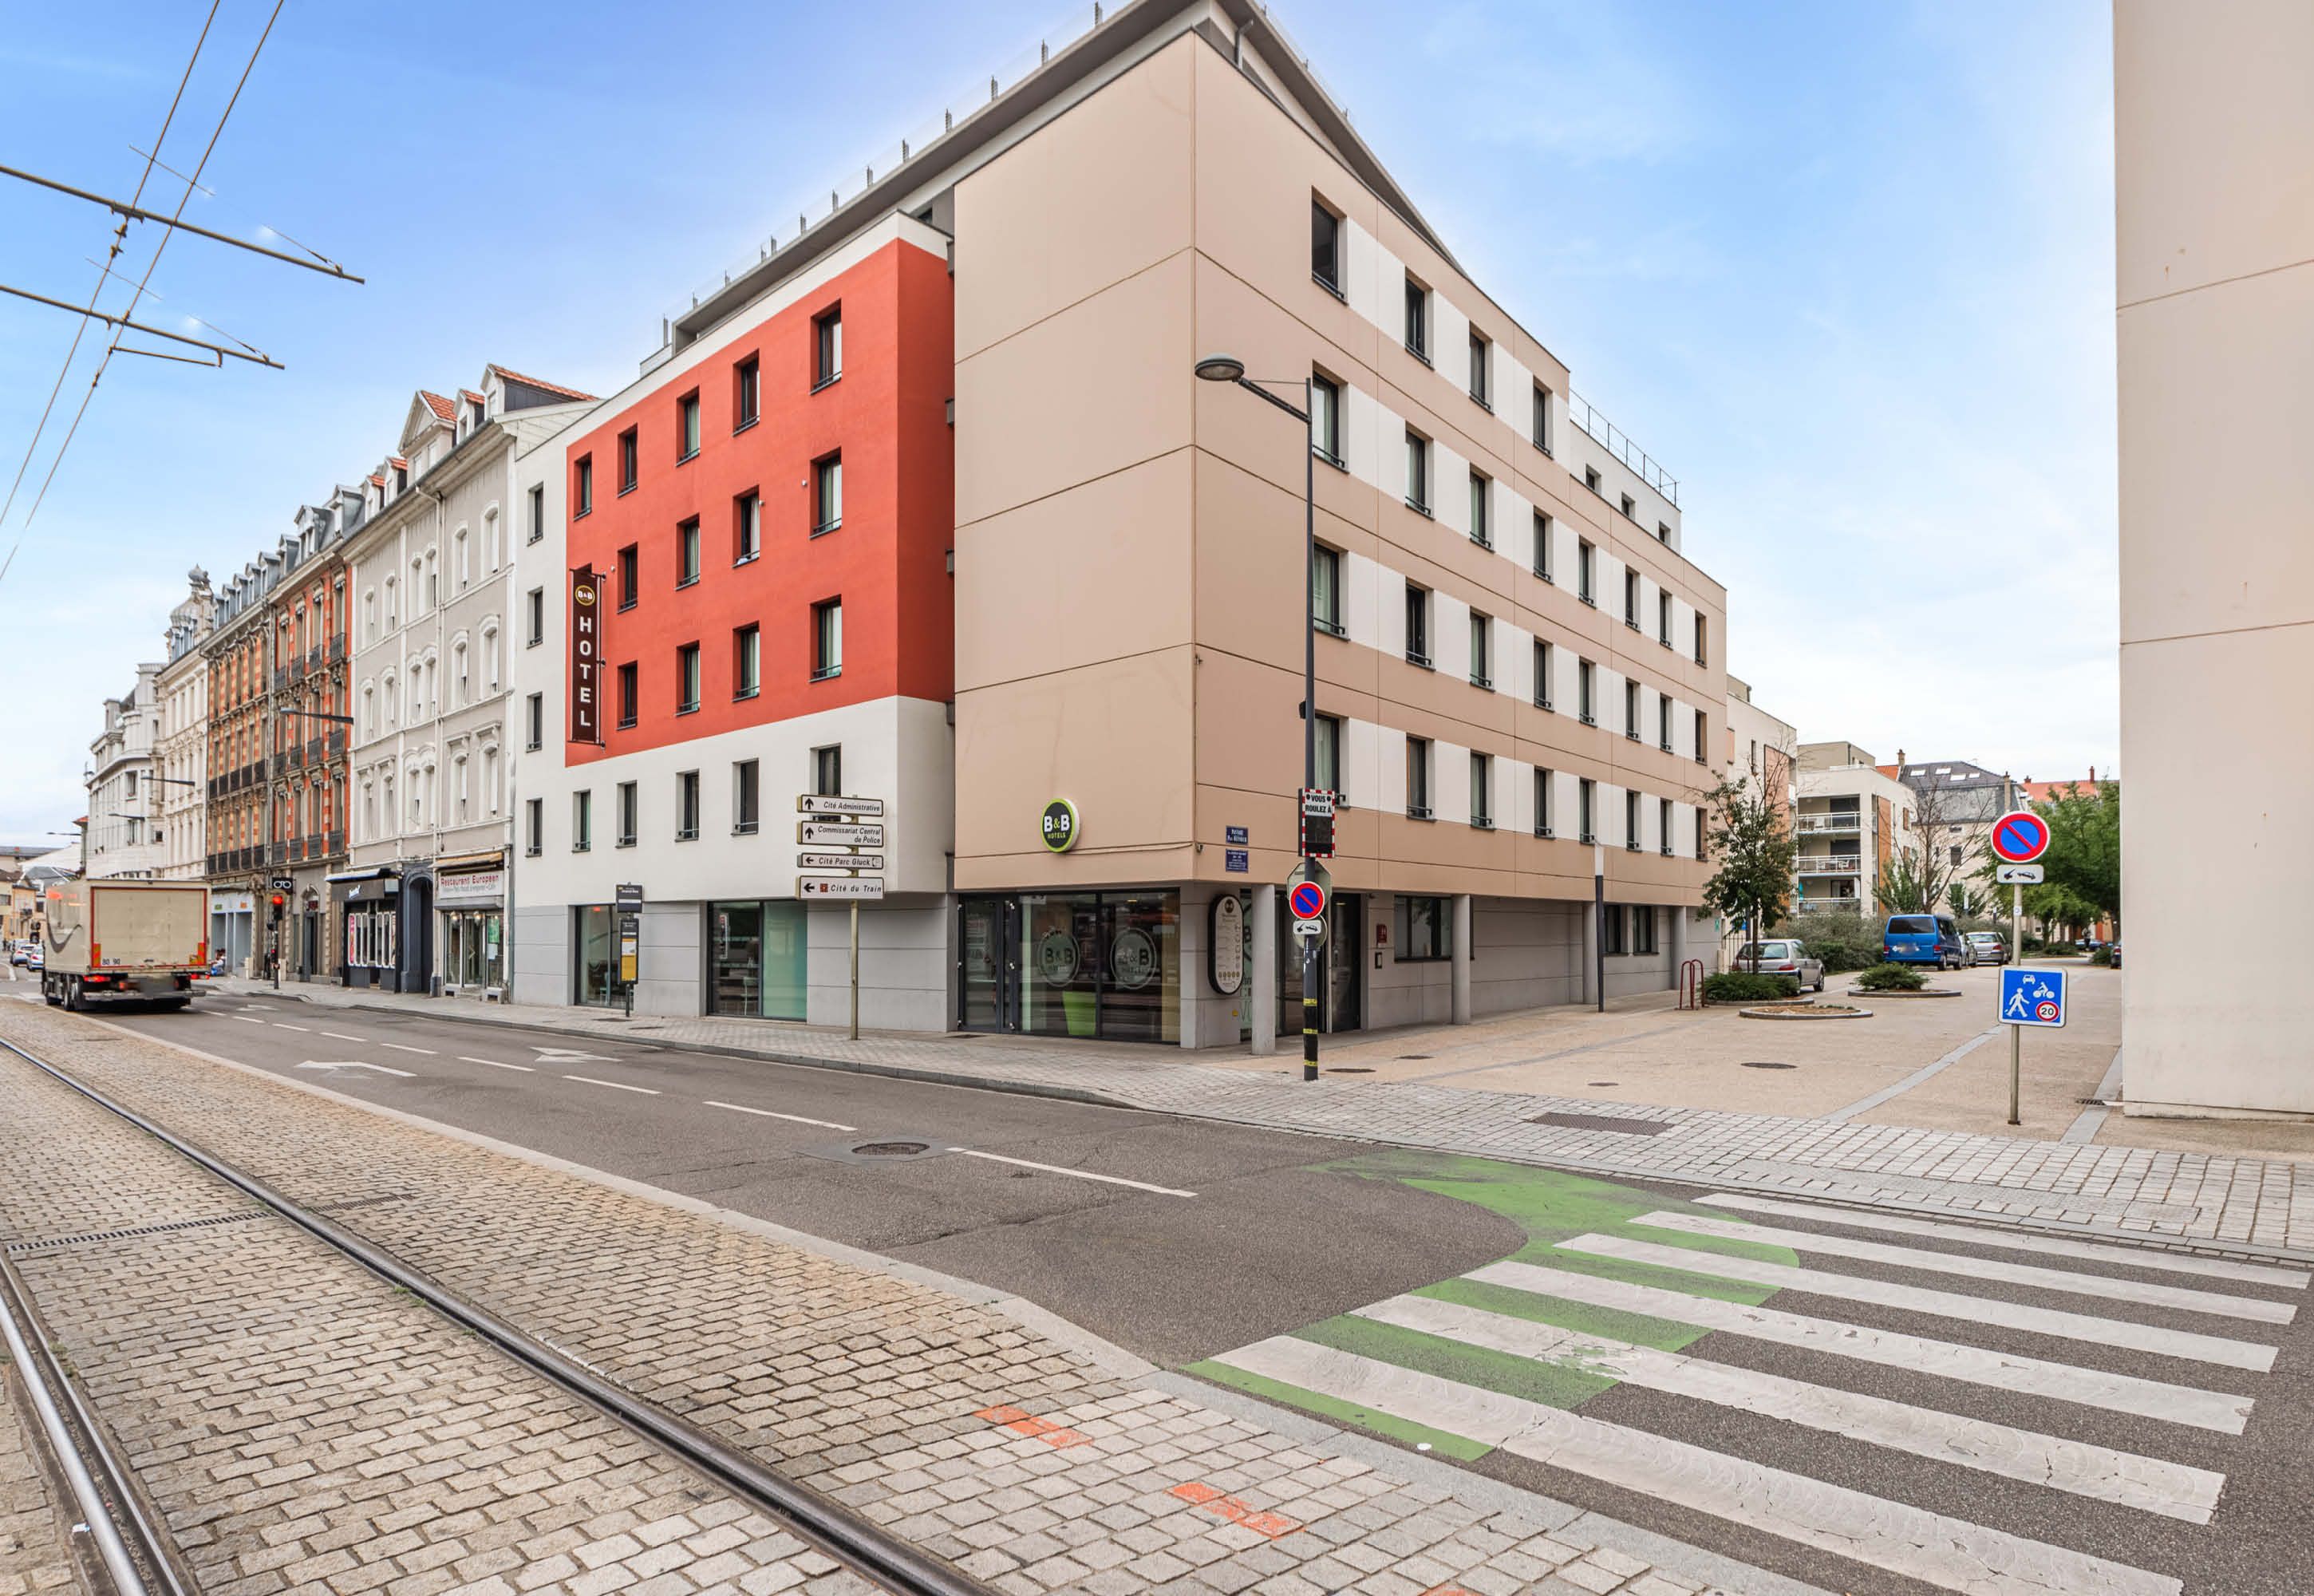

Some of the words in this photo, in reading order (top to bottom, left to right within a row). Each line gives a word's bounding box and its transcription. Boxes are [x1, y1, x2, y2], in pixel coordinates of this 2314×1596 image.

[579, 616, 592, 727] HOTEL
[1311, 794, 1325, 803] VOUS
[823, 800, 837, 809] Cité
[838, 802, 880, 812] Administrative
[1044, 814, 1070, 832] B&B
[818, 825, 858, 835] Commissariat
[863, 836, 881, 844] Police
[851, 858, 871, 867] Gluck
[2041, 1007, 2055, 1016] 20
